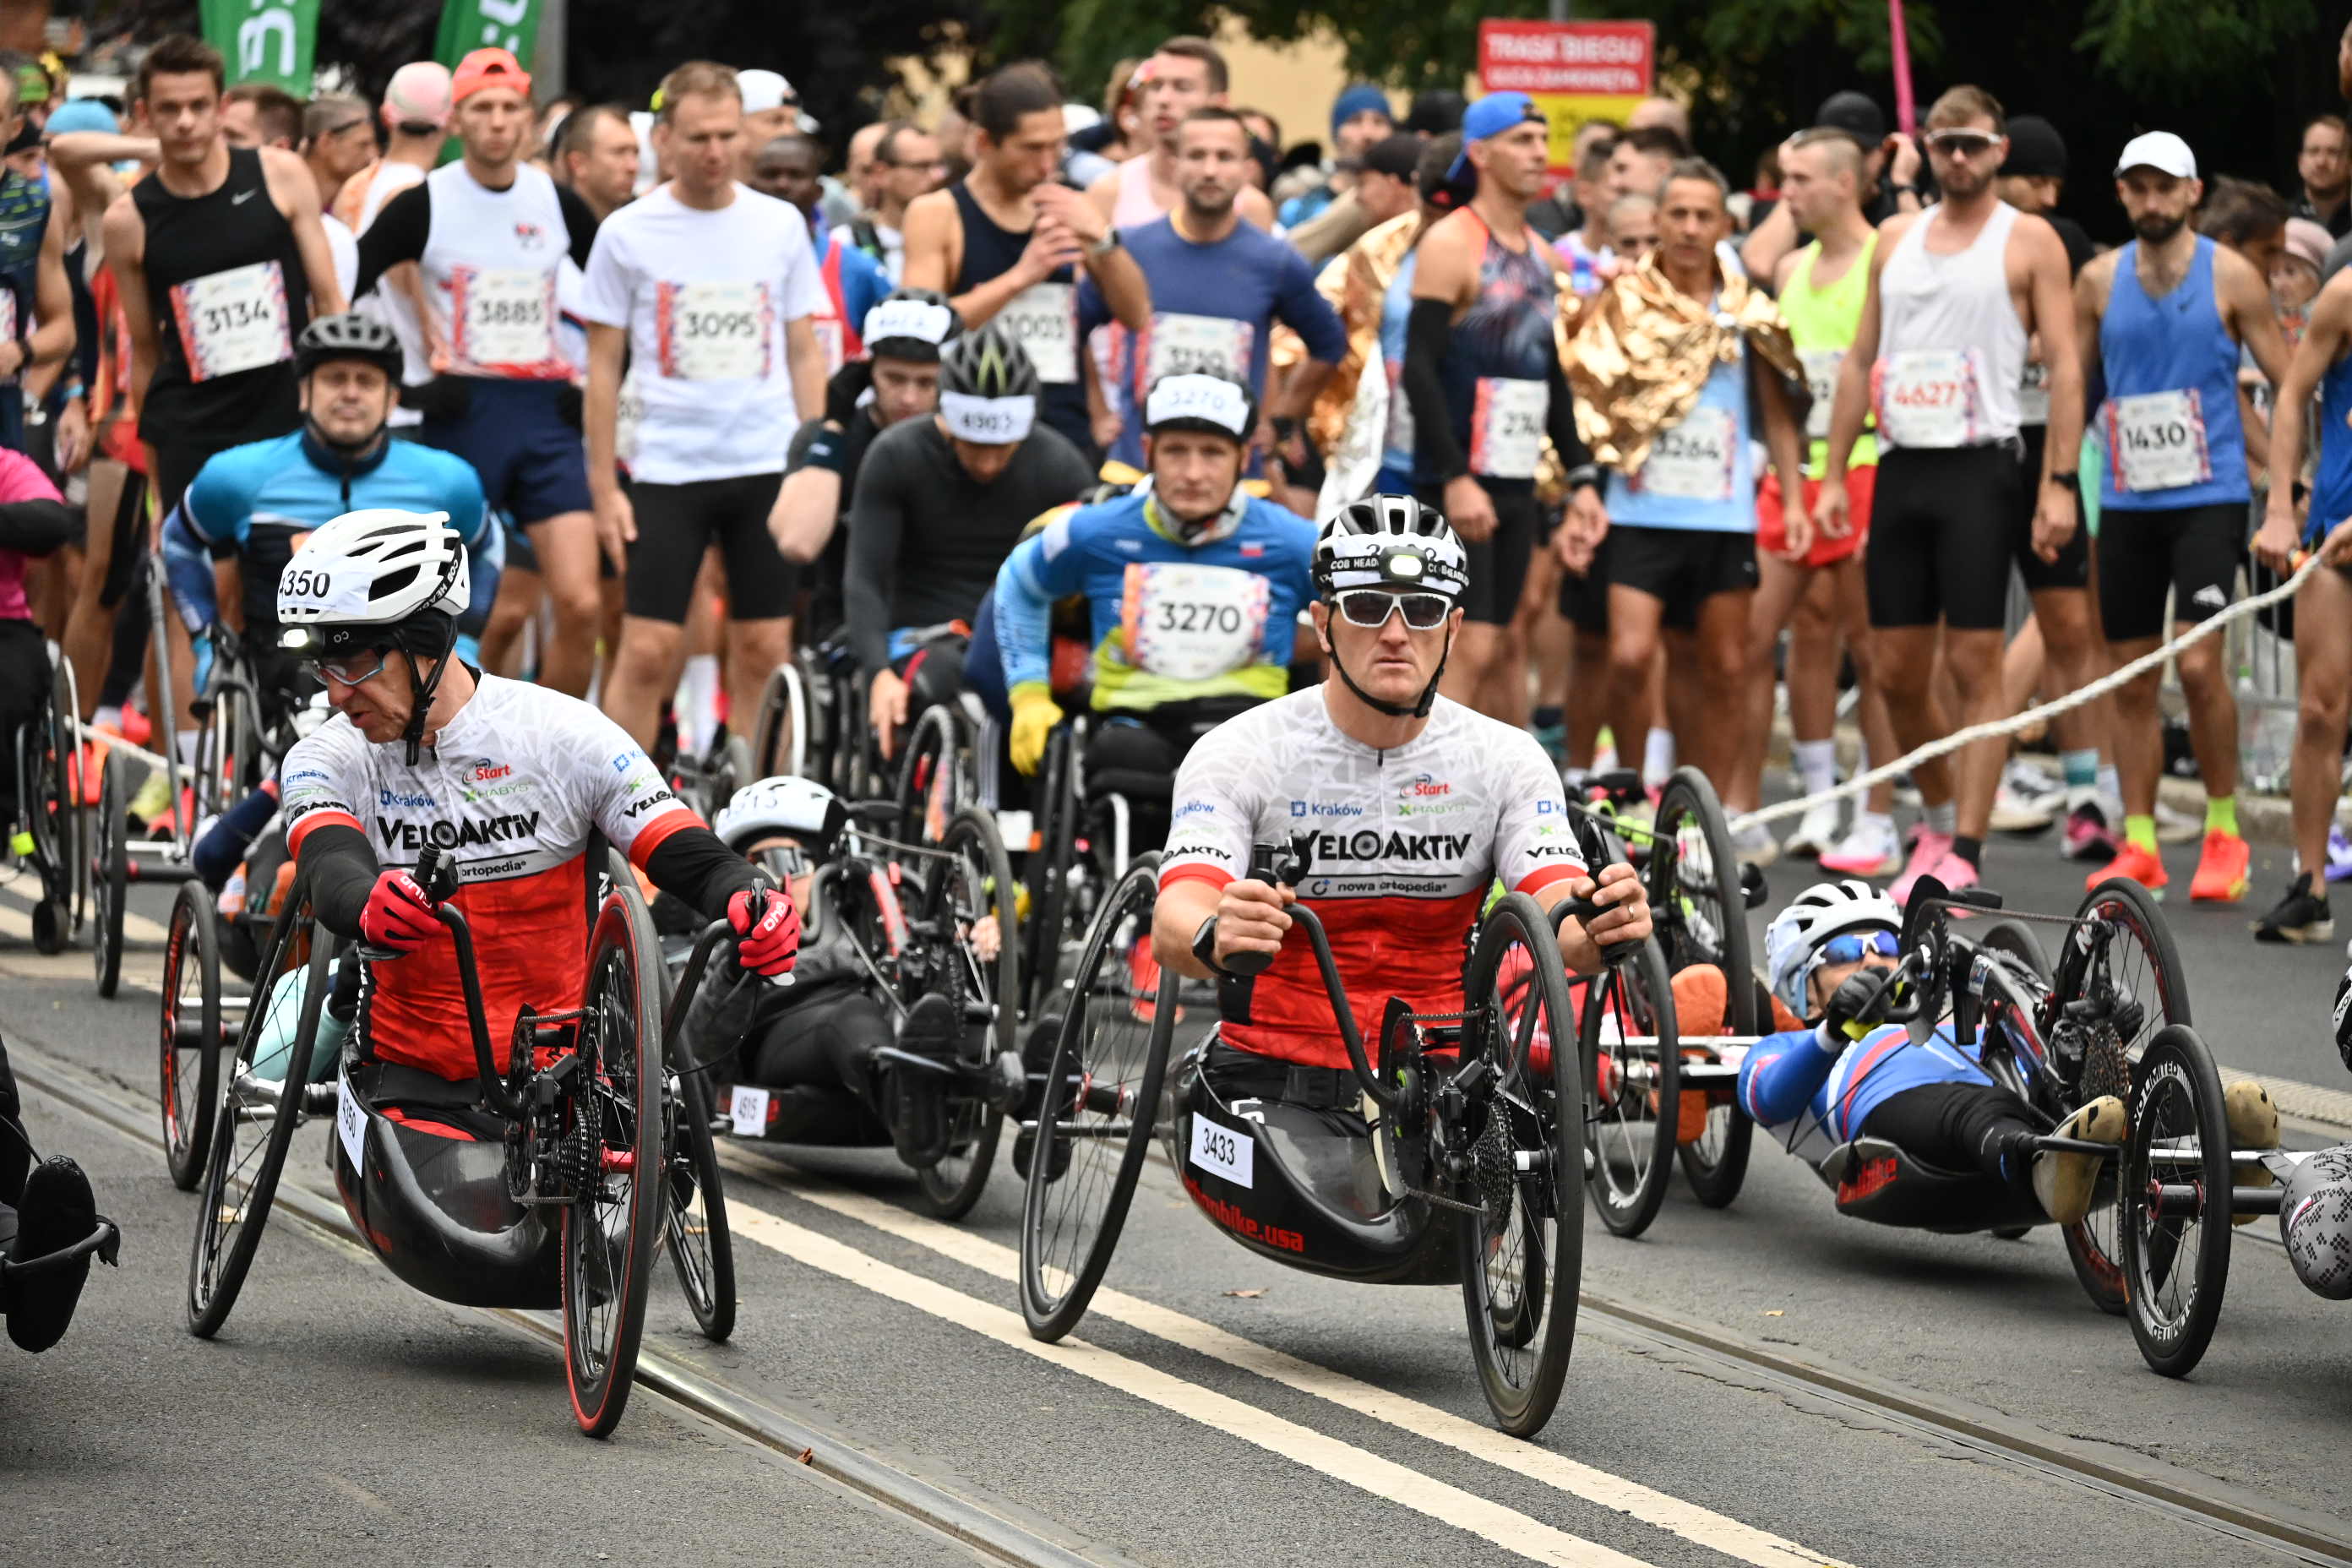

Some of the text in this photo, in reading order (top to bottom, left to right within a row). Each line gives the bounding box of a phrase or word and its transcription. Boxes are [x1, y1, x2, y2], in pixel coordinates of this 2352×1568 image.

[203, 301, 271, 335] 3134
[684, 311, 757, 338] 3095
[1894, 380, 1959, 406] 4627
[2126, 421, 2187, 453] 1430
[1330, 558, 1350, 570] COB
[1157, 601, 1242, 634] 3270
[476, 764, 512, 781] Start
[1415, 782, 1450, 797] Start
[1311, 803, 1364, 817] Kraków
[1337, 882, 1375, 894] nowa
[2143, 1059, 2180, 1094] LIMITED
[342, 1092, 357, 1139] 4350
[1202, 1127, 1235, 1167] 3433
